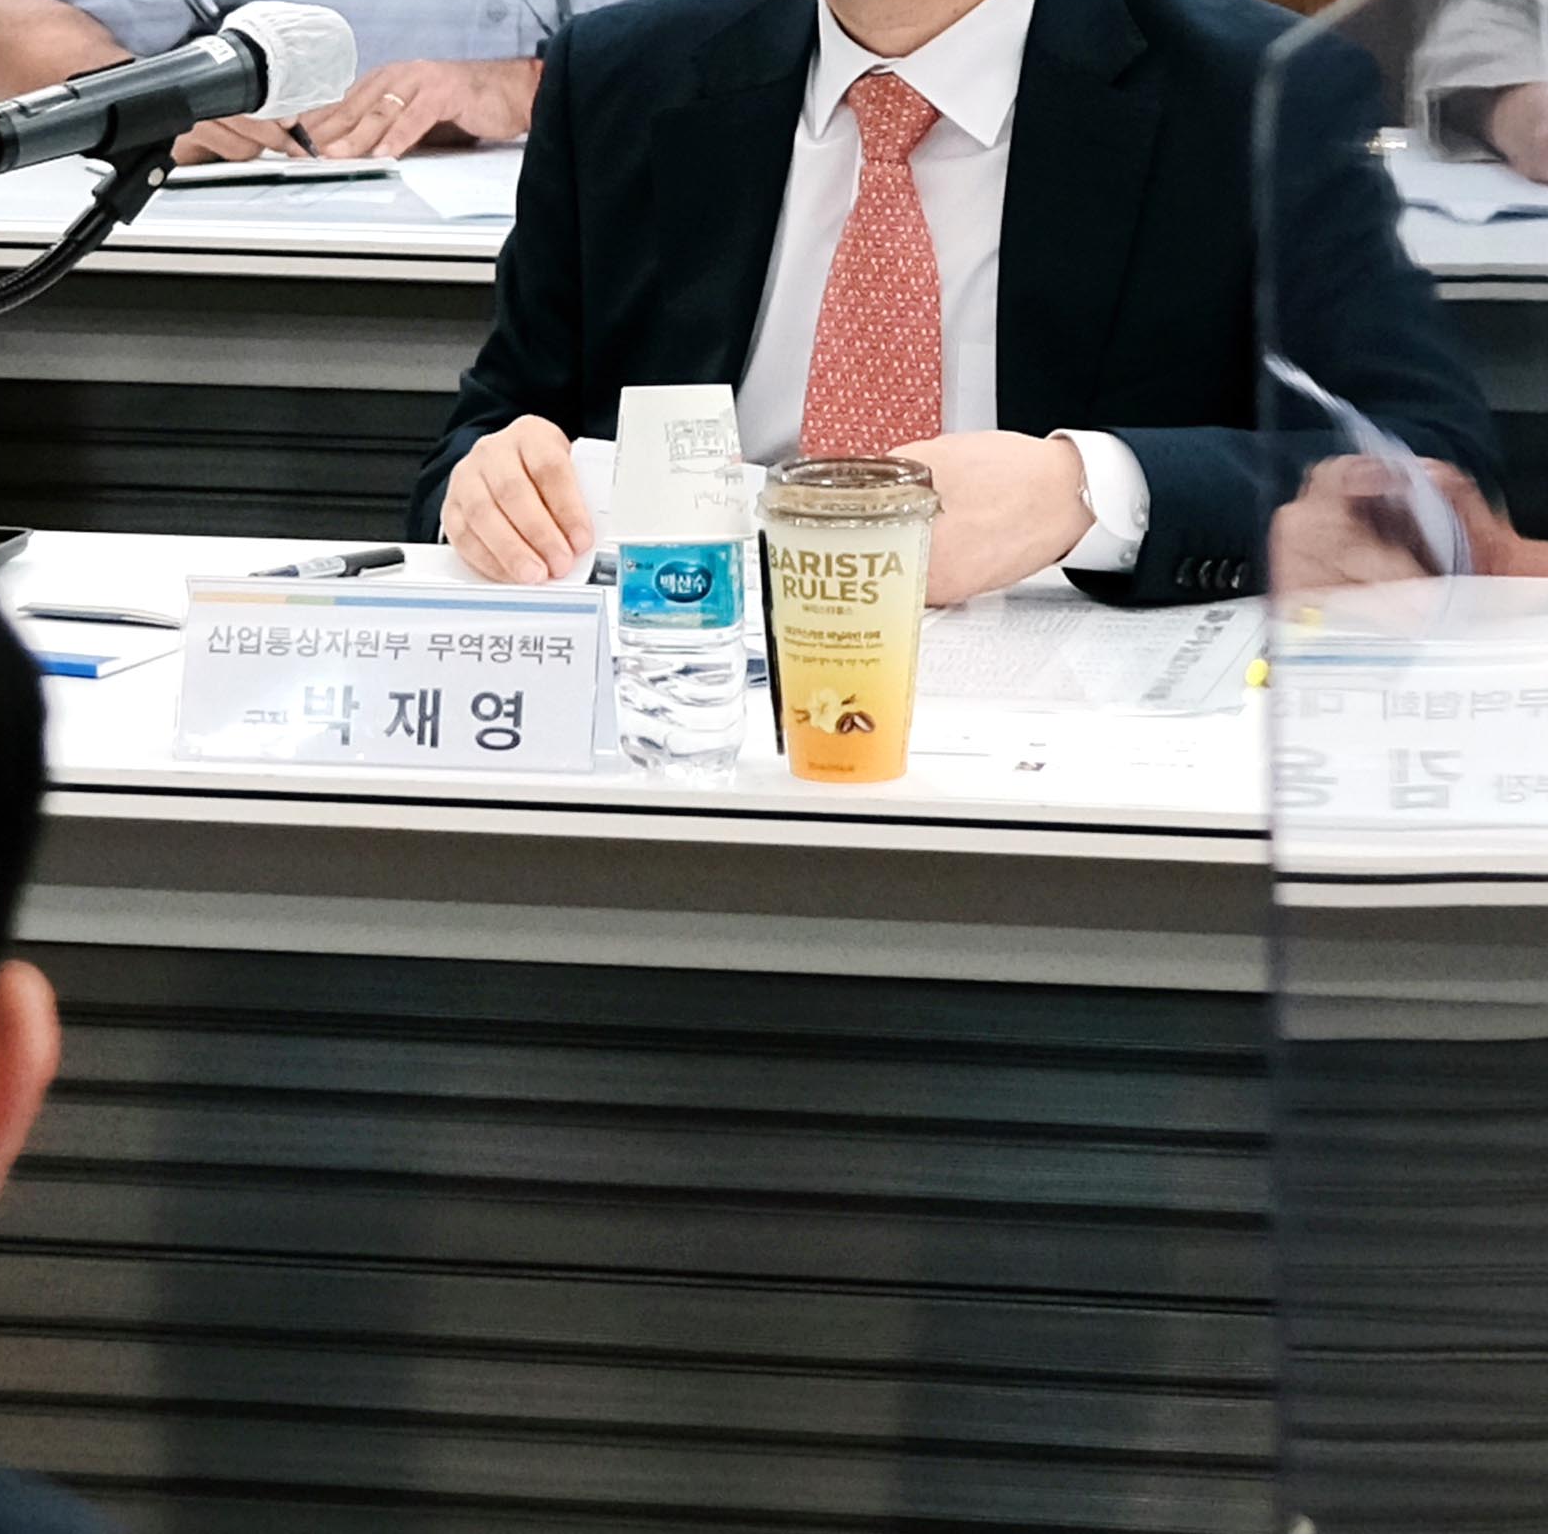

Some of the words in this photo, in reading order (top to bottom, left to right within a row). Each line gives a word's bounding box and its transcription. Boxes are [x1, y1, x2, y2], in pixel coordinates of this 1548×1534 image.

[768, 543, 905, 578] BARISTA
[659, 572, 707, 595] 백산수
[782, 574, 880, 605] RULES
[206, 624, 412, 661] 산업통상자원부
[426, 632, 576, 666] 무역정책국
